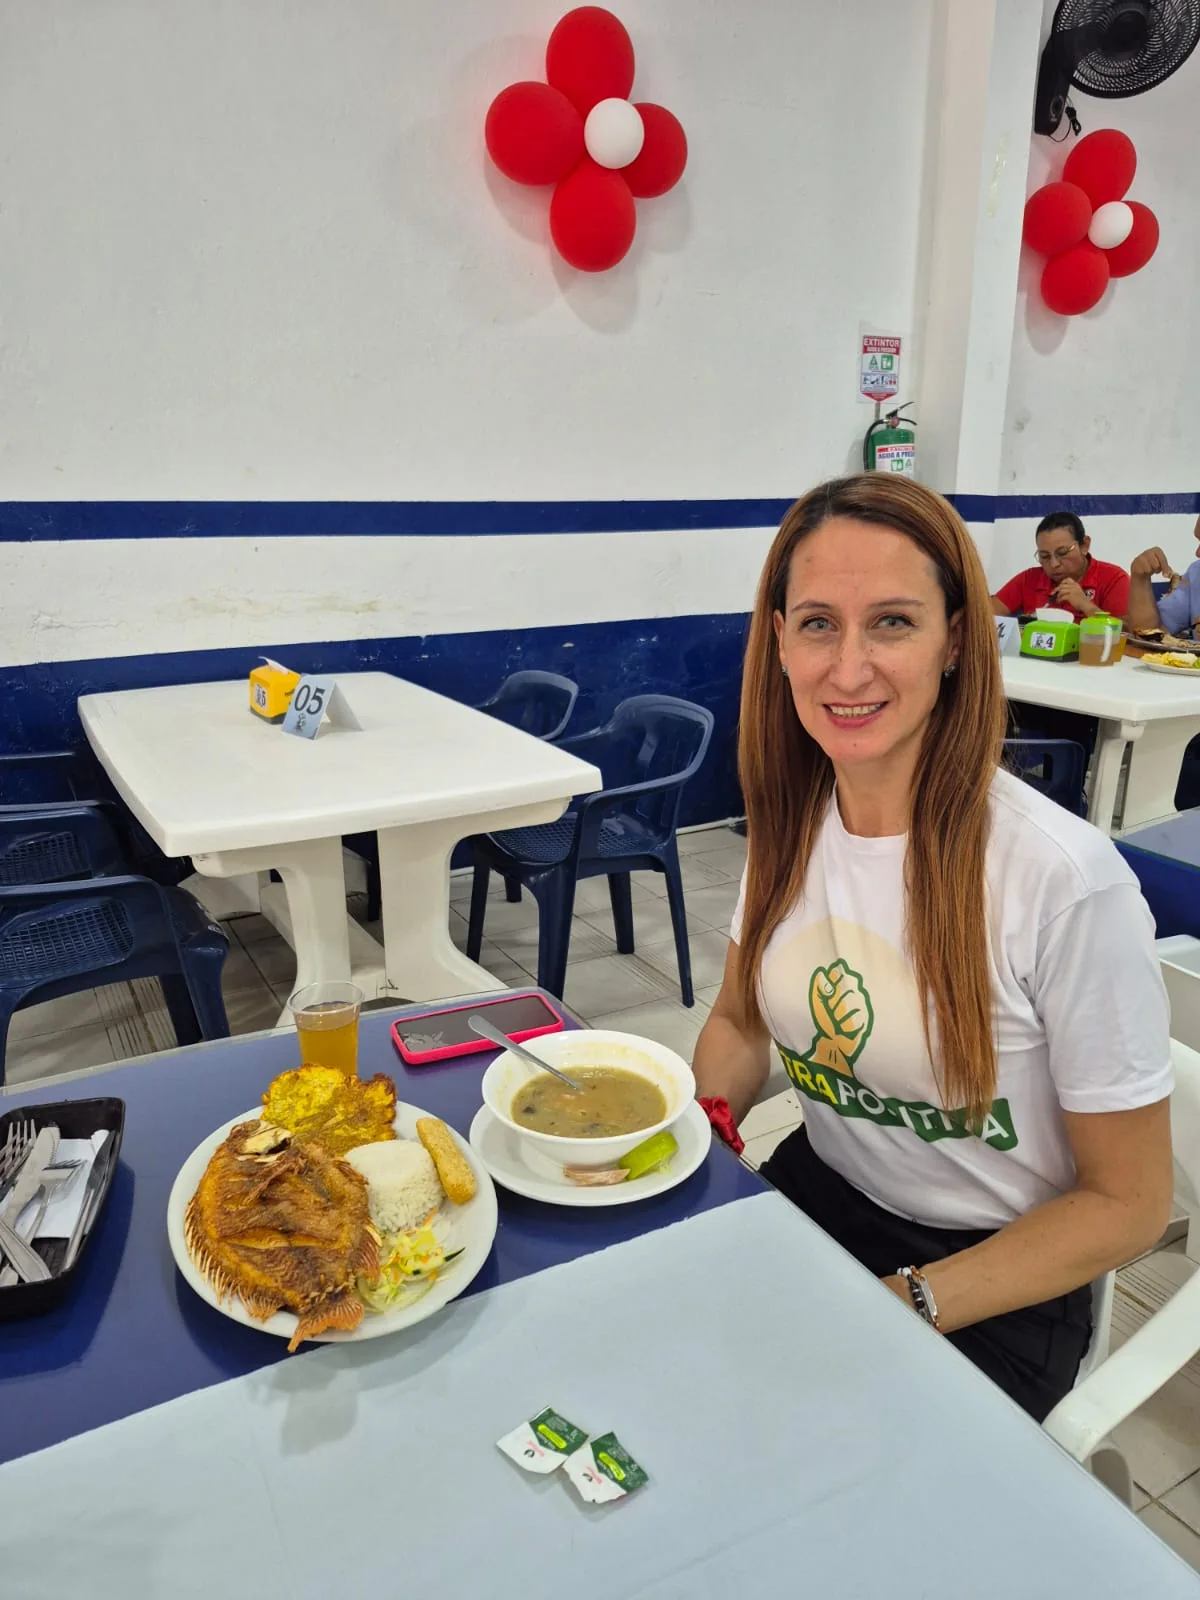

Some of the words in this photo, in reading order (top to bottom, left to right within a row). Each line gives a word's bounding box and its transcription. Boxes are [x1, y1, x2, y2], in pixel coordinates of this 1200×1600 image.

[863, 338, 900, 347] EXTINTOR
[1046, 636, 1054, 648] 4
[294, 684, 326, 715] 05
